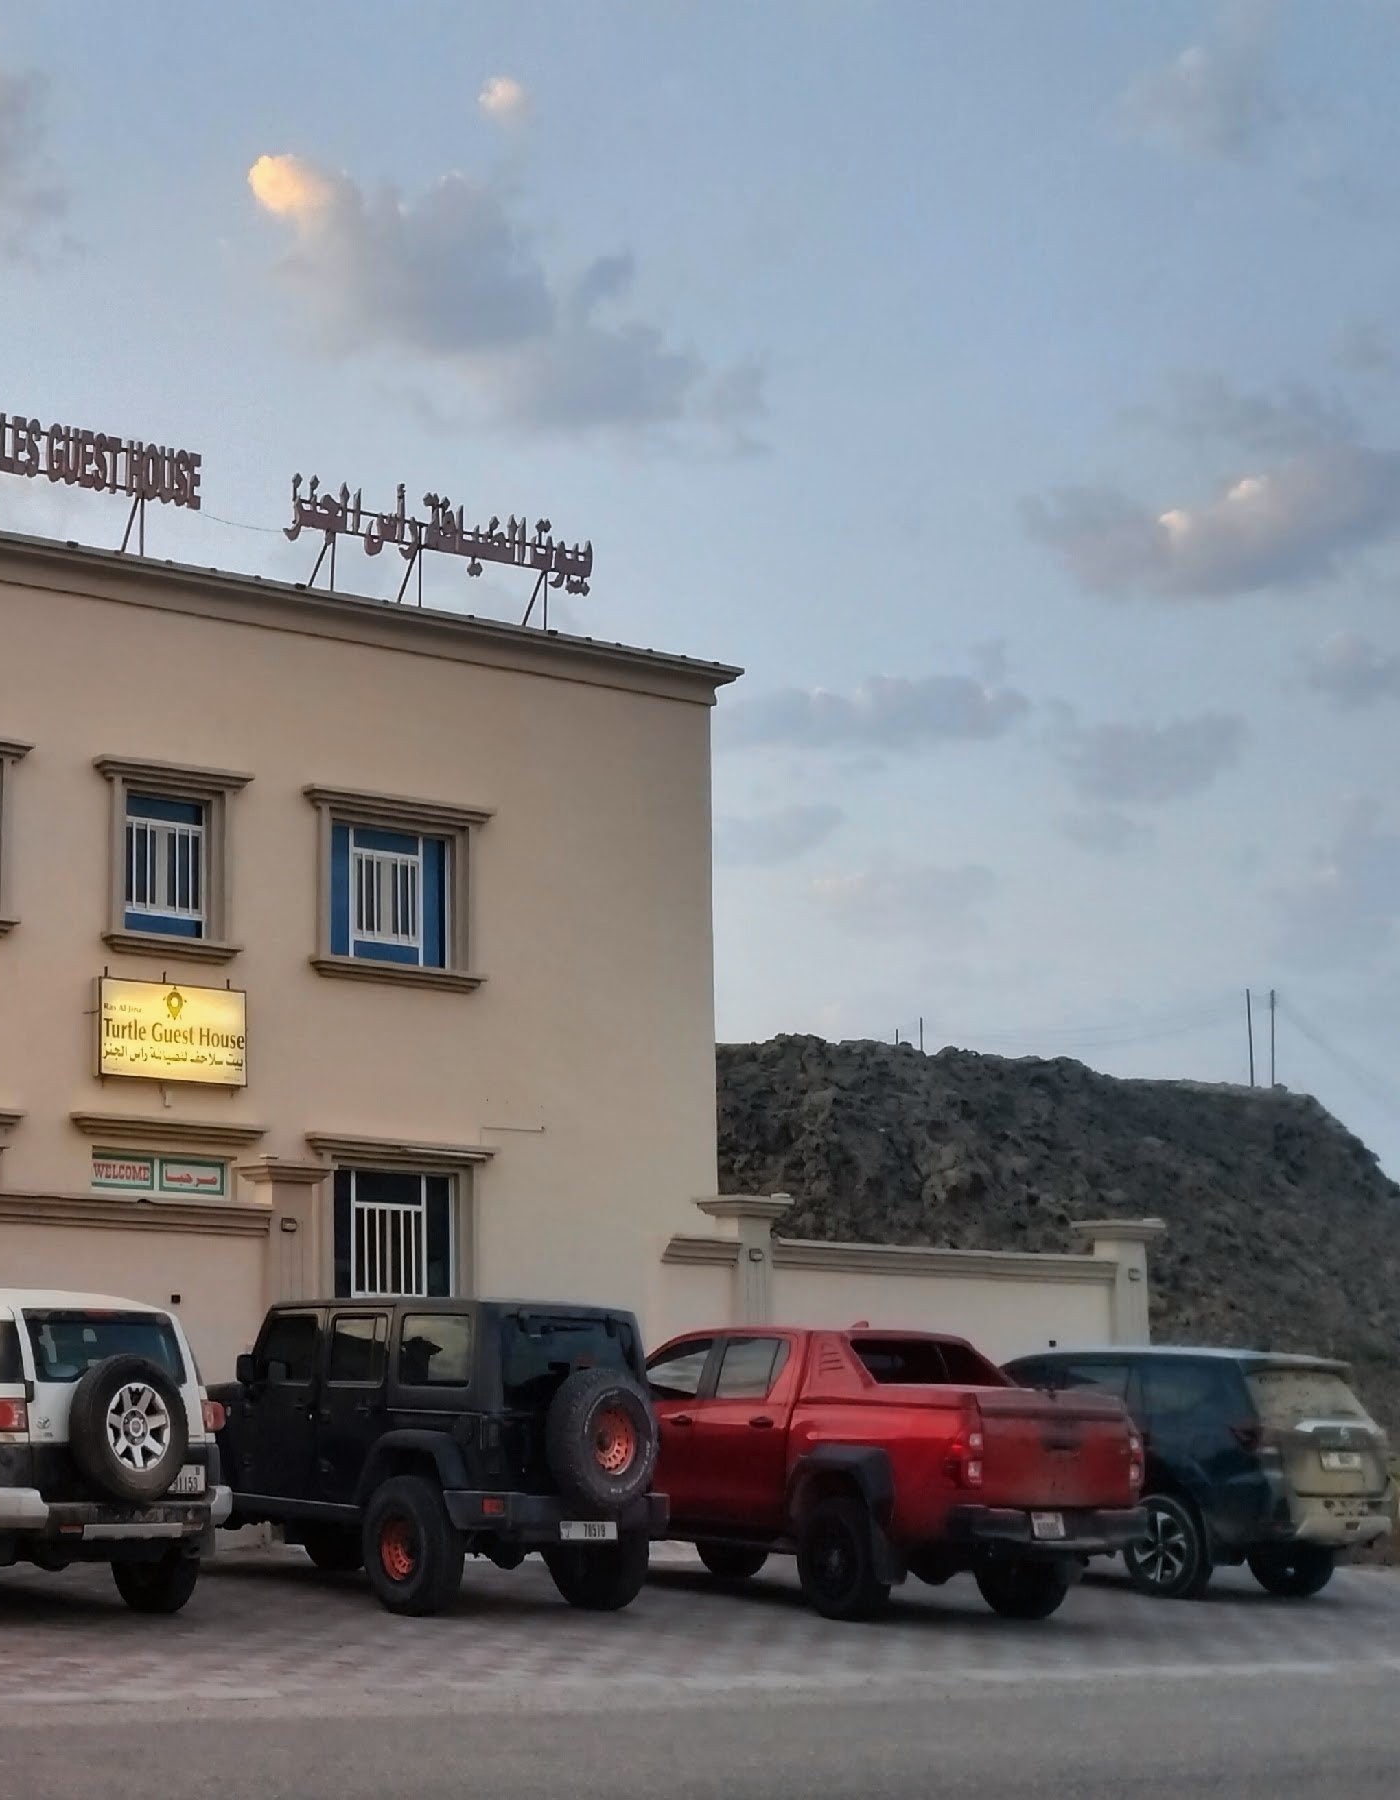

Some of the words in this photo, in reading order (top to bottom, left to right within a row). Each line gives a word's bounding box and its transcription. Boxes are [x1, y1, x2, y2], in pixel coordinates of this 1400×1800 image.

[47, 423, 121, 494] GUEST
[126, 439, 202, 510] HOUSE
[103, 1017, 147, 1041] Turtle
[151, 1022, 194, 1046] Guest
[199, 1027, 245, 1050] House
[93, 1163, 150, 1182] WELCOME
